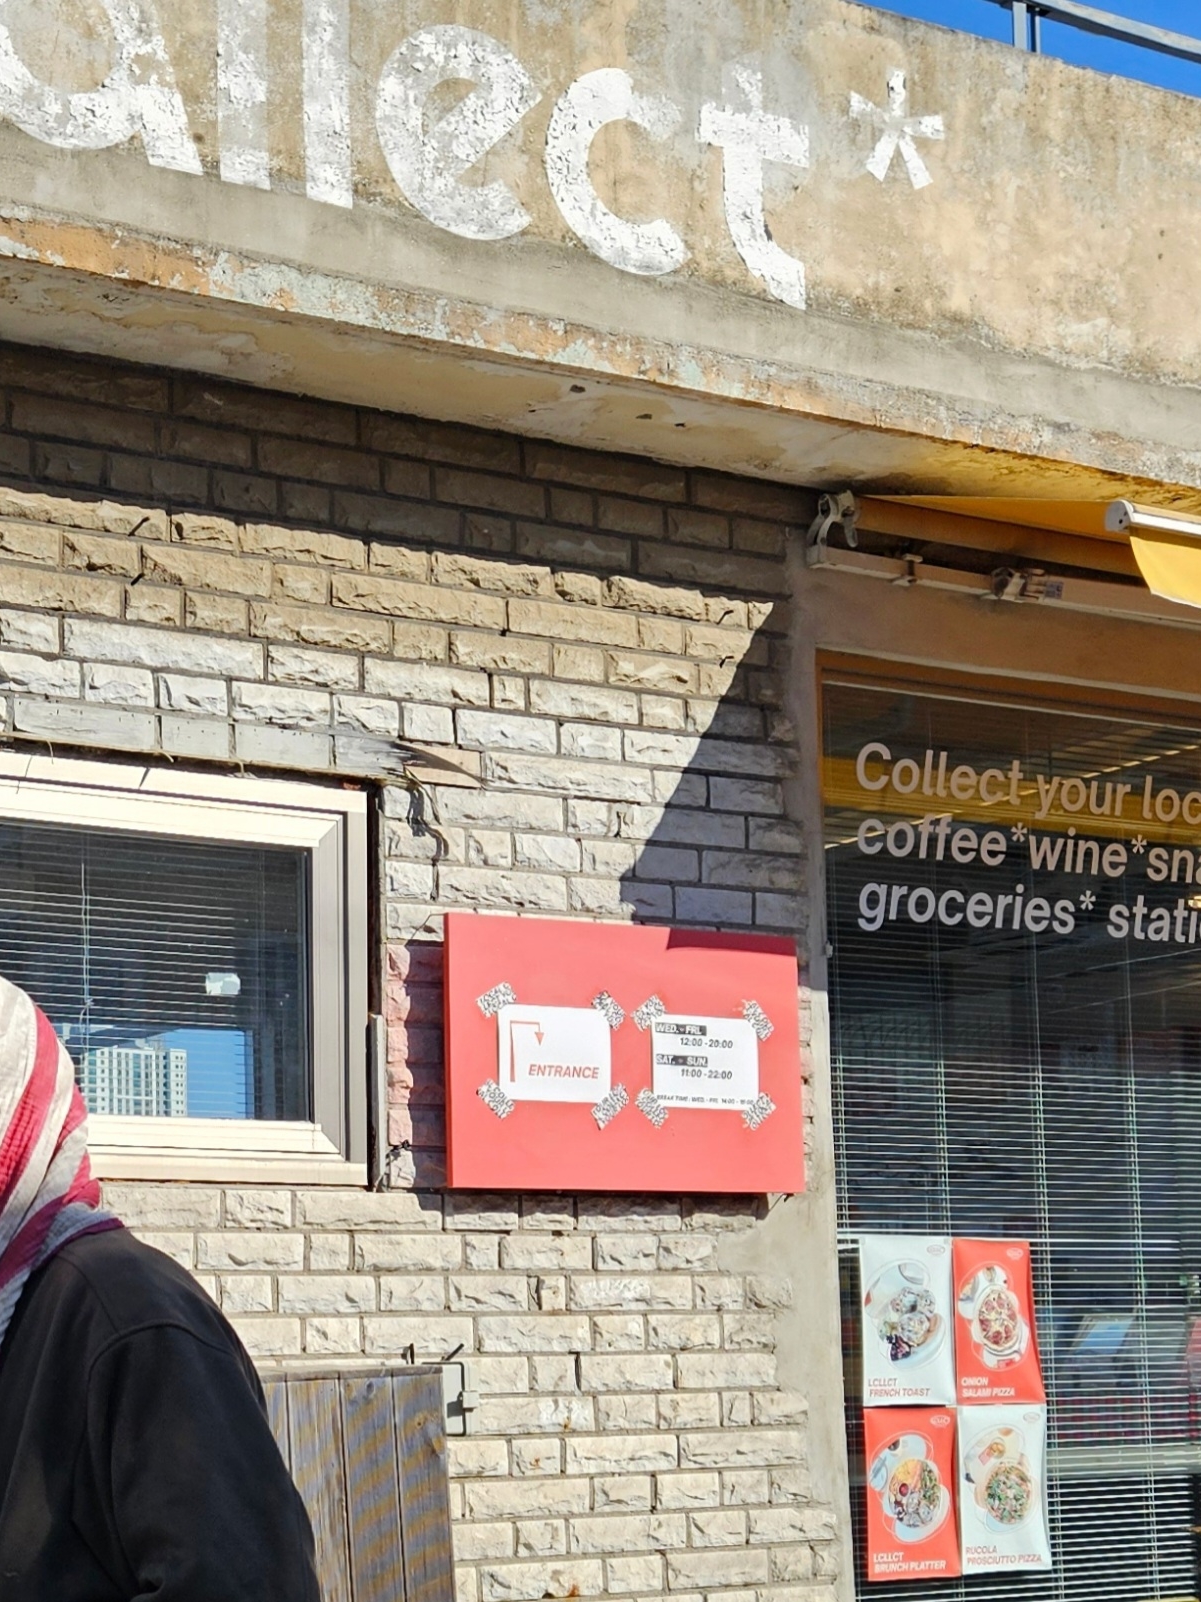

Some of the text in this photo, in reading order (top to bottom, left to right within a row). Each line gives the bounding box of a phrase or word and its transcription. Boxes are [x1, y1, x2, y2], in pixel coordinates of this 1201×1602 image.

[856, 742, 1024, 806] Collect
[1035, 773, 1132, 820] your
[1106, 895, 1201, 945] stati
[680, 1037, 703, 1047] 12:00
[708, 1039, 733, 1049] 20:00
[528, 1064, 600, 1080] ENTRANCE
[681, 1068, 703, 1078] 11:00
[707, 1070, 733, 1080] 22:00
[961, 1377, 989, 1386] ONION
[869, 1387, 931, 1398] FRENCH TOAST
[966, 1553, 1042, 1565] PROSCIUTTO PIZZA
